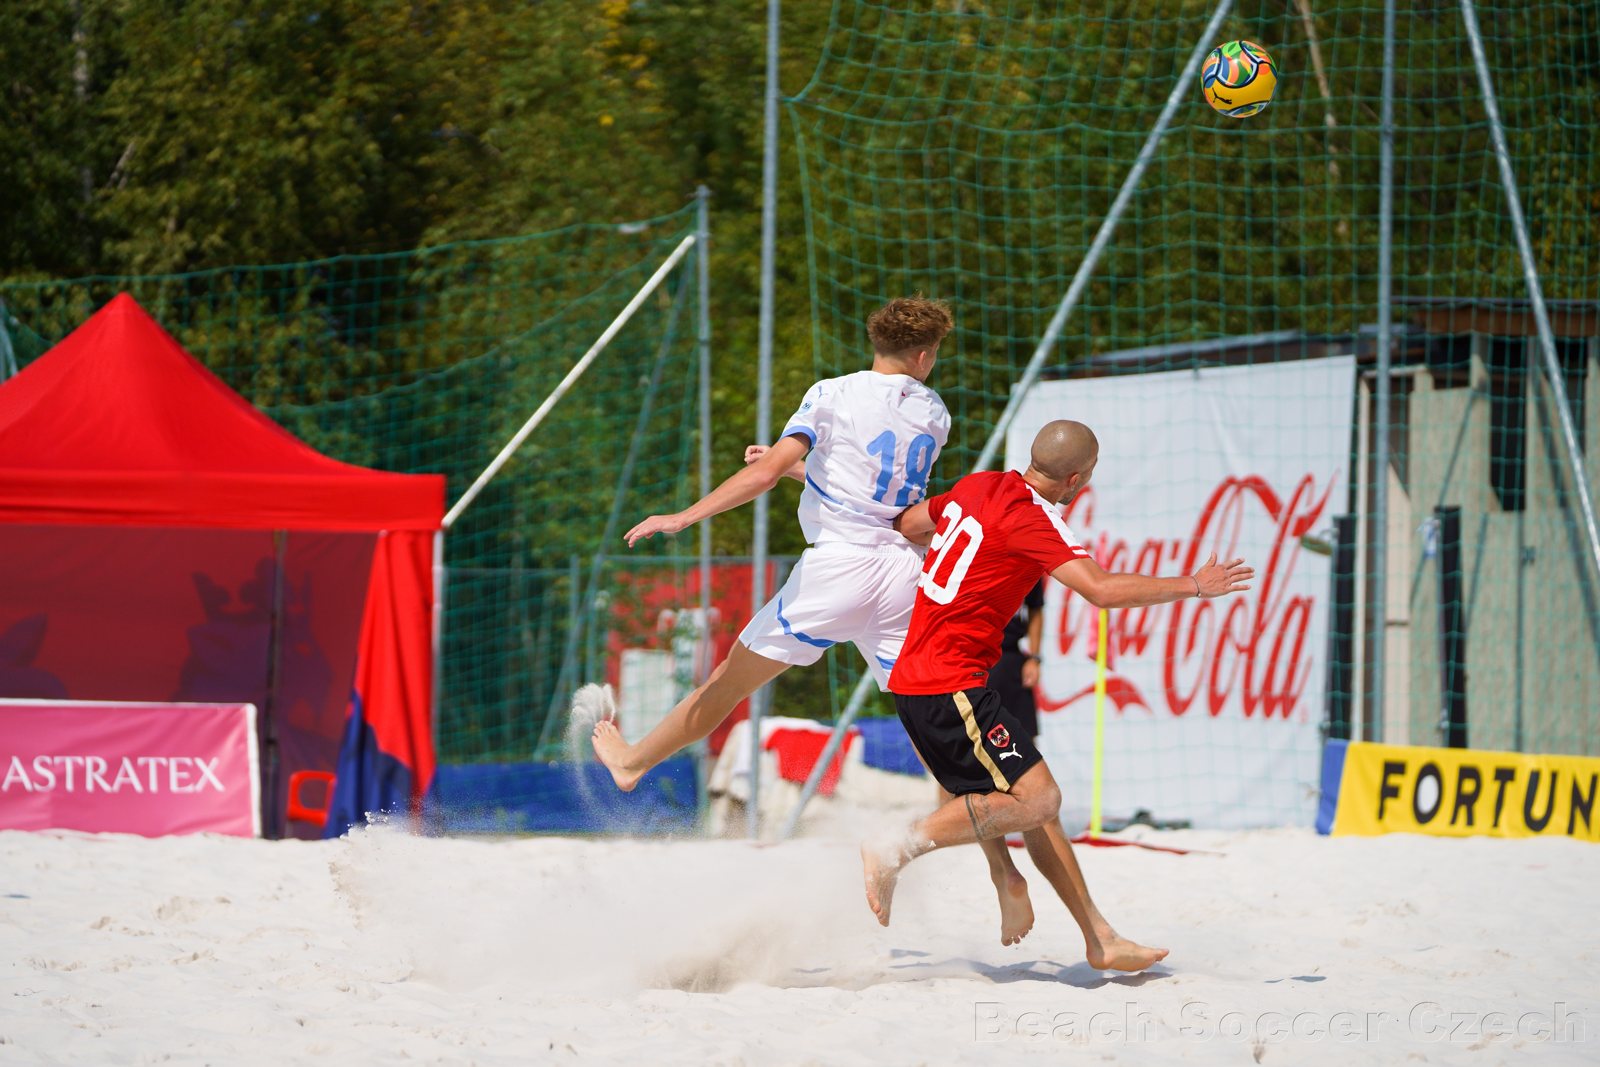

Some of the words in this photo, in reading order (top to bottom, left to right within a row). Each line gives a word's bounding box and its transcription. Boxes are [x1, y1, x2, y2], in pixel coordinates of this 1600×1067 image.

[867, 430, 936, 507] 18
[918, 500, 984, 605] 20
[1, 755, 225, 794] ASTRATEX
